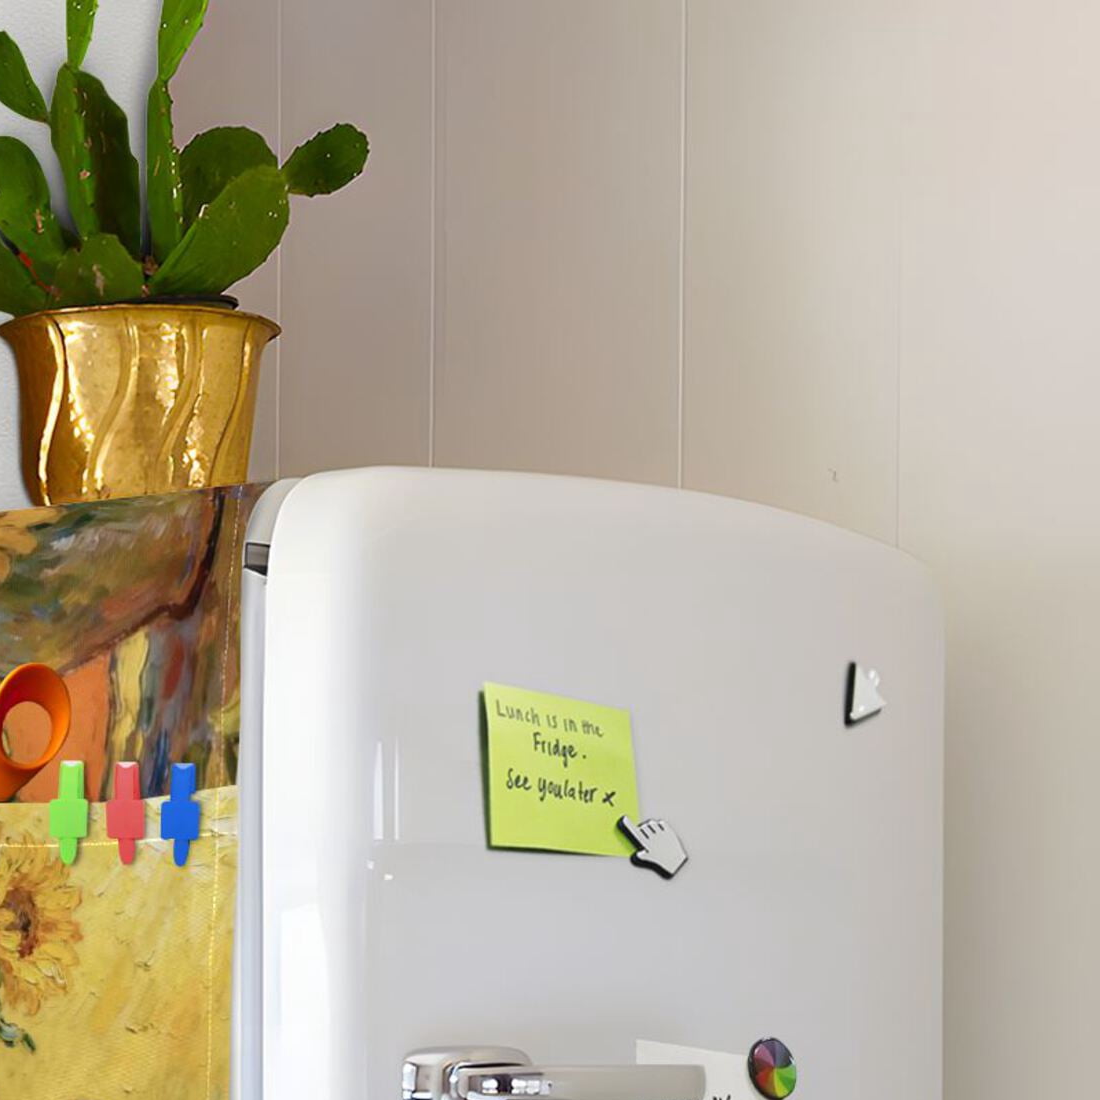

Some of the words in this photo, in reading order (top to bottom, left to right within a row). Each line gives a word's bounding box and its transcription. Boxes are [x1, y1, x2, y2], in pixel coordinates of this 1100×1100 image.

[496, 699, 540, 727] Lunch
[547, 715, 557, 729] is
[564, 718, 577, 733] in
[582, 721, 604, 738] the
[506, 768, 532, 791] See
